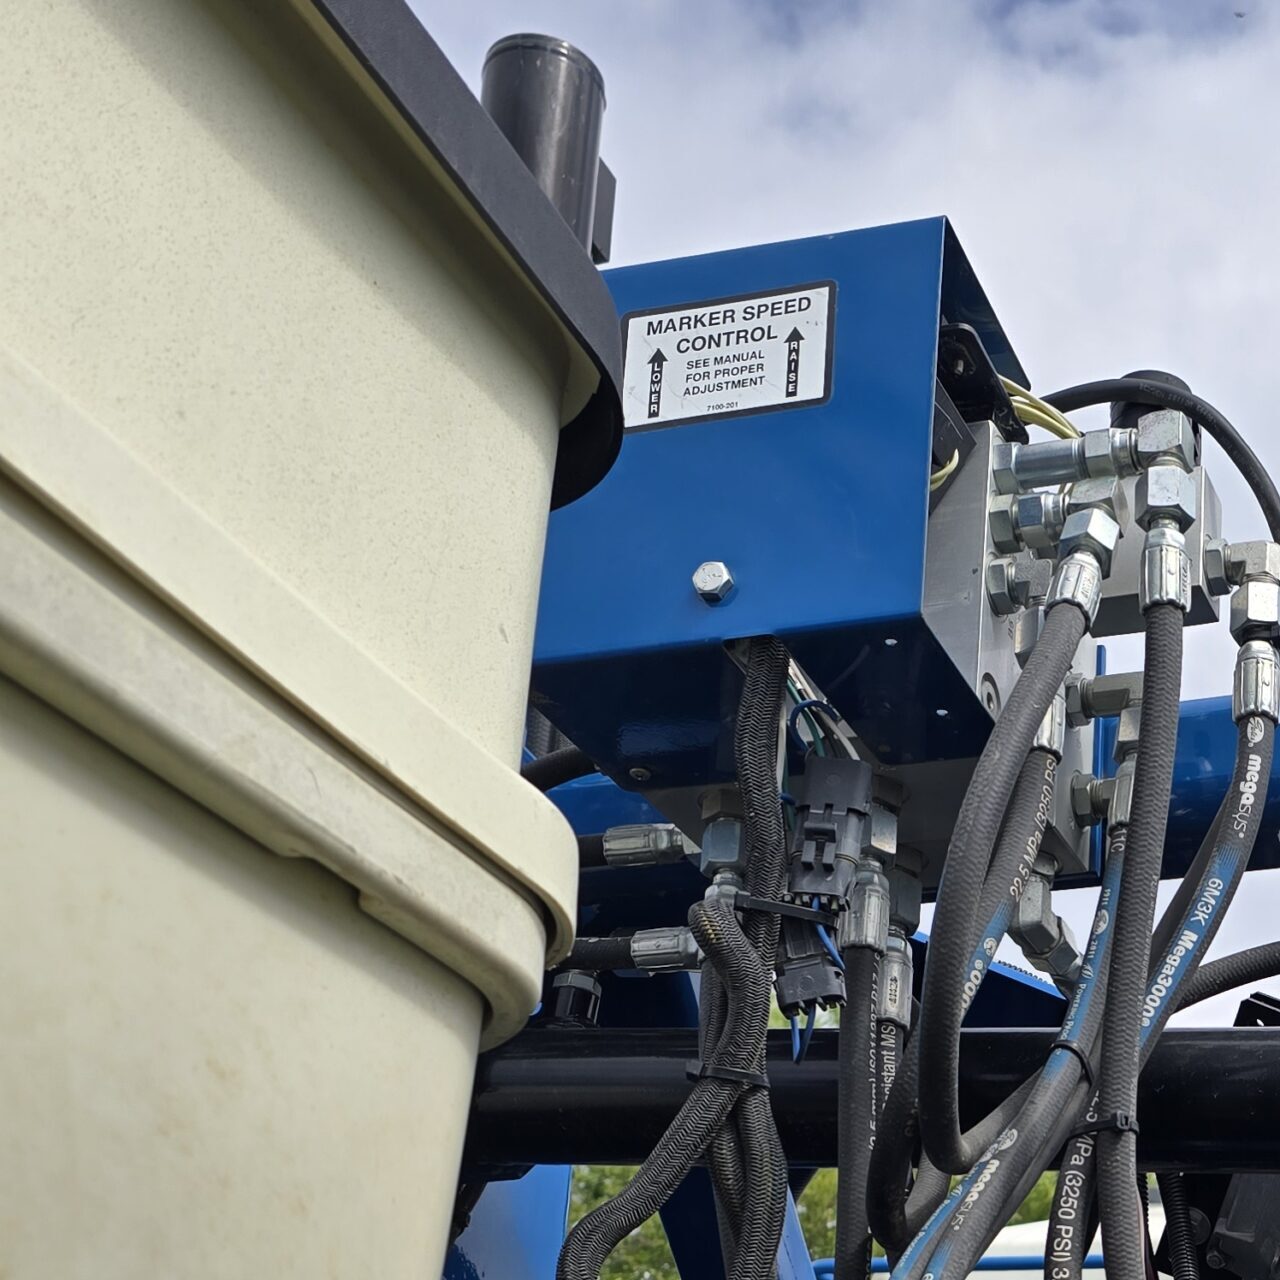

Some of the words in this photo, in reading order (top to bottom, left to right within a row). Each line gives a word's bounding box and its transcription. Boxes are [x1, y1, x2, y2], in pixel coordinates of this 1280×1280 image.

[646, 309, 736, 336] MARKER
[742, 296, 812, 322] SPEED
[676, 325, 778, 354] CONTROL
[685, 371, 711, 383] FOR
[714, 363, 764, 380] PROPER
[686, 358, 710, 370] SEE
[713, 350, 765, 366] MANUAL
[788, 341, 798, 392] RAISE
[650, 362, 661, 414] LOWER
[683, 376, 766, 396] ADJUSTMENT
[1190, 877, 1224, 927] 6M3K
[1057, 1170, 1086, 1220] (3250
[1050, 1225, 1074, 1262] PSI)
